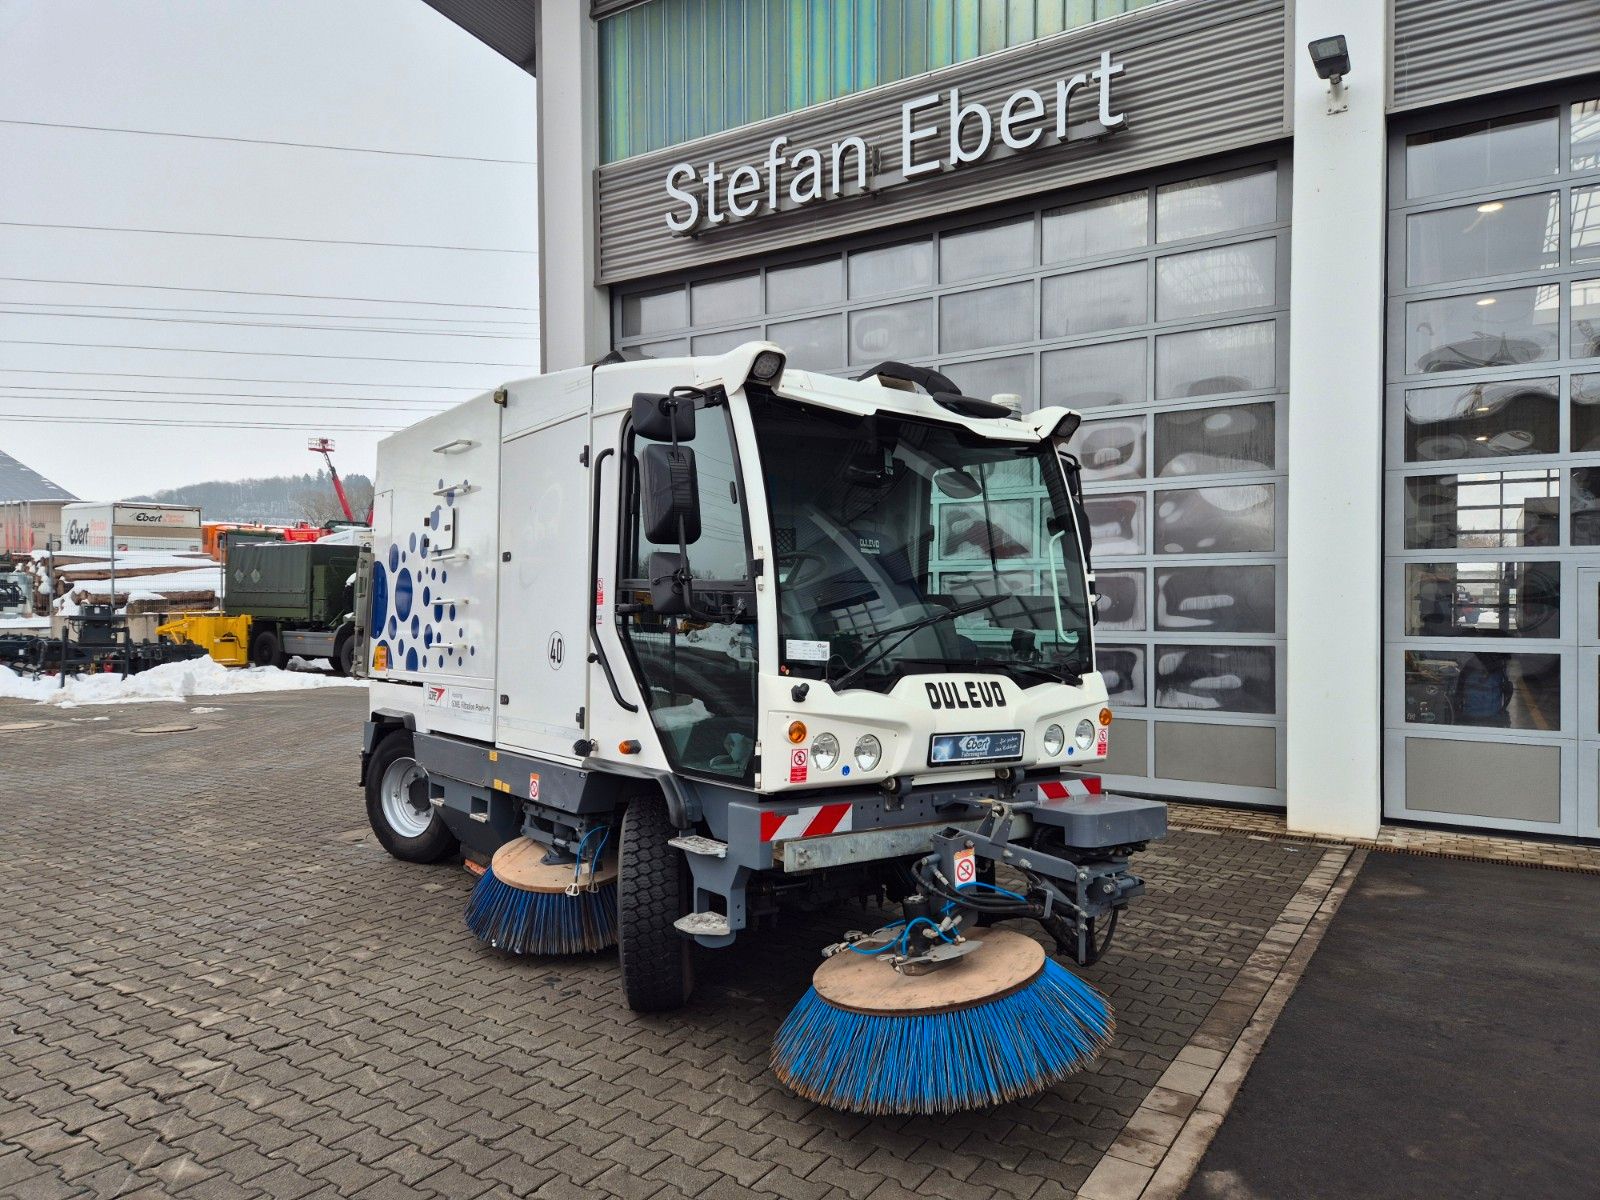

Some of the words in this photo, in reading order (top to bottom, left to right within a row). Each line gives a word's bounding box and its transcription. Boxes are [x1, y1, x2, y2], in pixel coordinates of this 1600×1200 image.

[665, 136, 867, 232] Stefan
[902, 50, 1126, 180] Ebert
[136, 512, 162, 522] Ebert
[550, 638, 562, 663] 40
[925, 681, 1007, 710] DULEVO
[966, 737, 990, 751] Ebert
